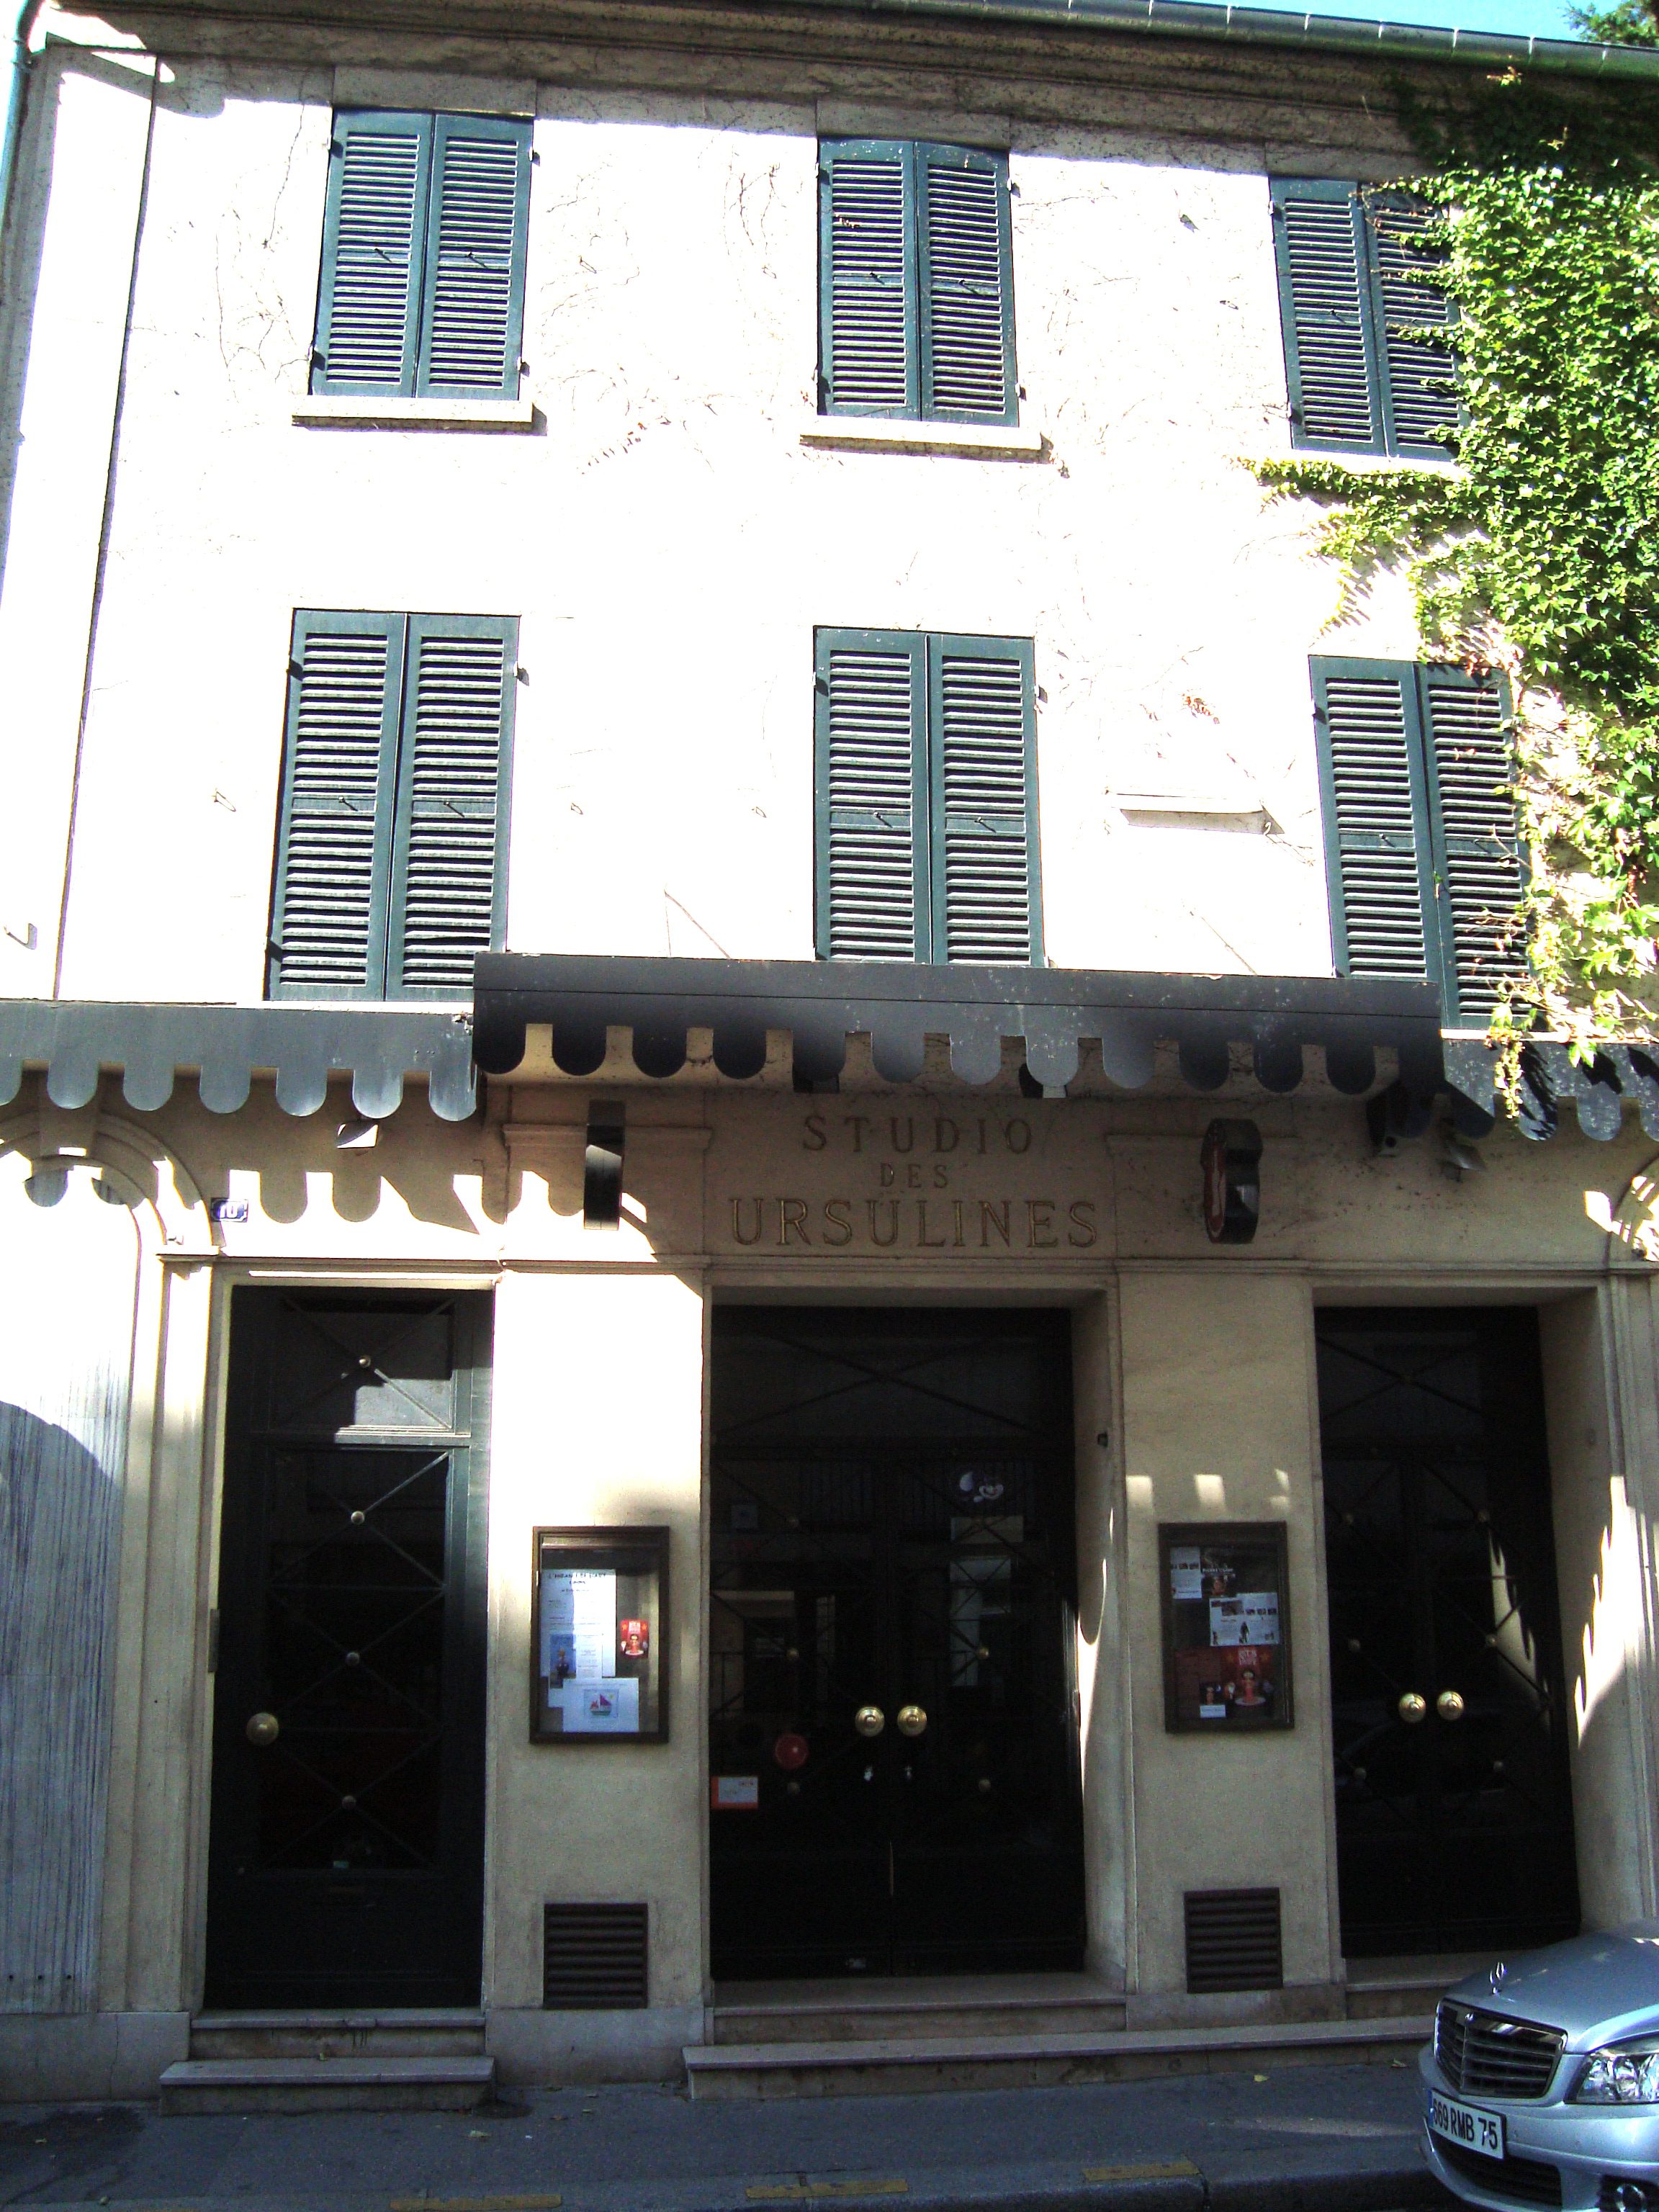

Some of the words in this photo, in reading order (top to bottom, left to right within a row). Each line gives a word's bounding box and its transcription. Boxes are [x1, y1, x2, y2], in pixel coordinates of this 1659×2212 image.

[802, 1114, 1033, 1153] STUDIO
[879, 1162, 949, 1189] DES
[220, 1202, 238, 1218] 10
[729, 1197, 1099, 1249] URSULINES
[1449, 2107, 1475, 2142] RMB
[1478, 2117, 1498, 2150] 75
